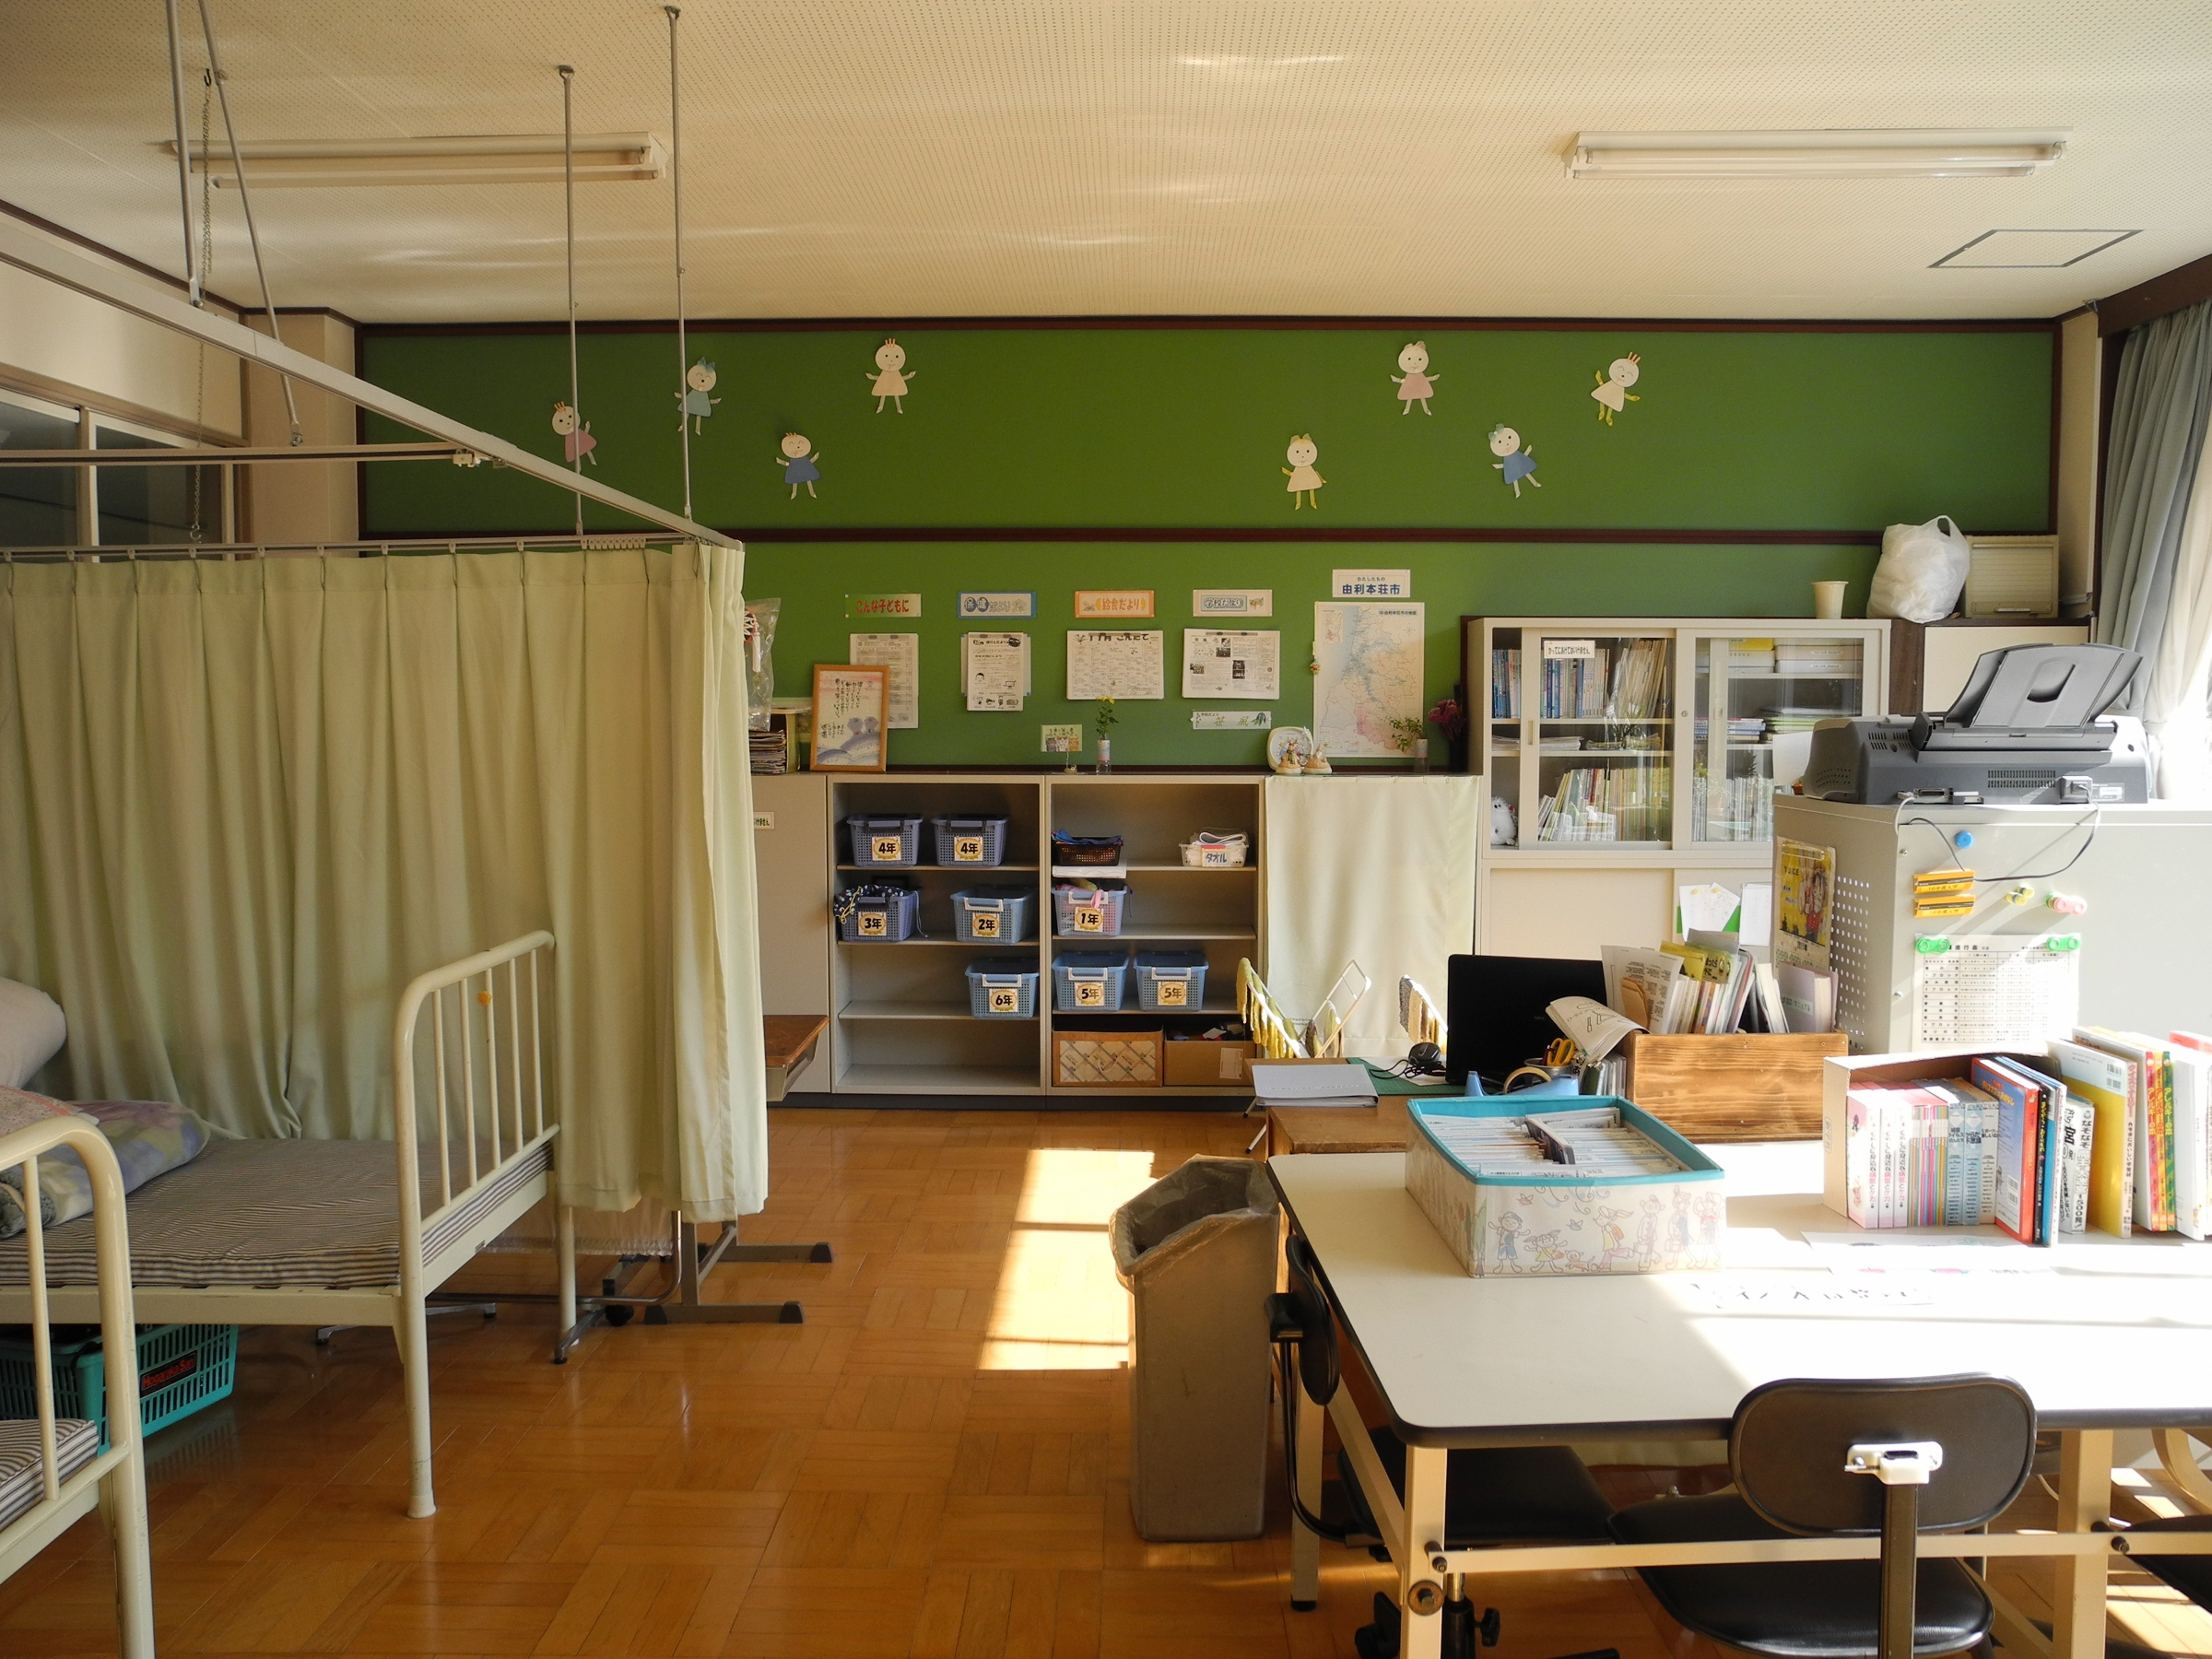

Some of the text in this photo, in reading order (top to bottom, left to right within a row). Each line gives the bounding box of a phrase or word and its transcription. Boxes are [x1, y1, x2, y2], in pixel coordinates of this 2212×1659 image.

[1342, 583, 1400, 594] 由利本荘市
[855, 599, 910, 614] こんな子どもに
[964, 597, 1010, 613] 保健だより
[1101, 597, 1140, 611] 給食だより
[878, 842, 896, 854] 4年
[960, 842, 978, 854] 4年
[1205, 853, 1227, 864] タオル
[864, 918, 882, 929] 3年
[1080, 912, 1099, 924] 1年
[978, 919, 995, 930] 2年
[1081, 988, 1100, 999] 5年
[1164, 988, 1182, 999] 5年
[995, 994, 1013, 1006] 6年
